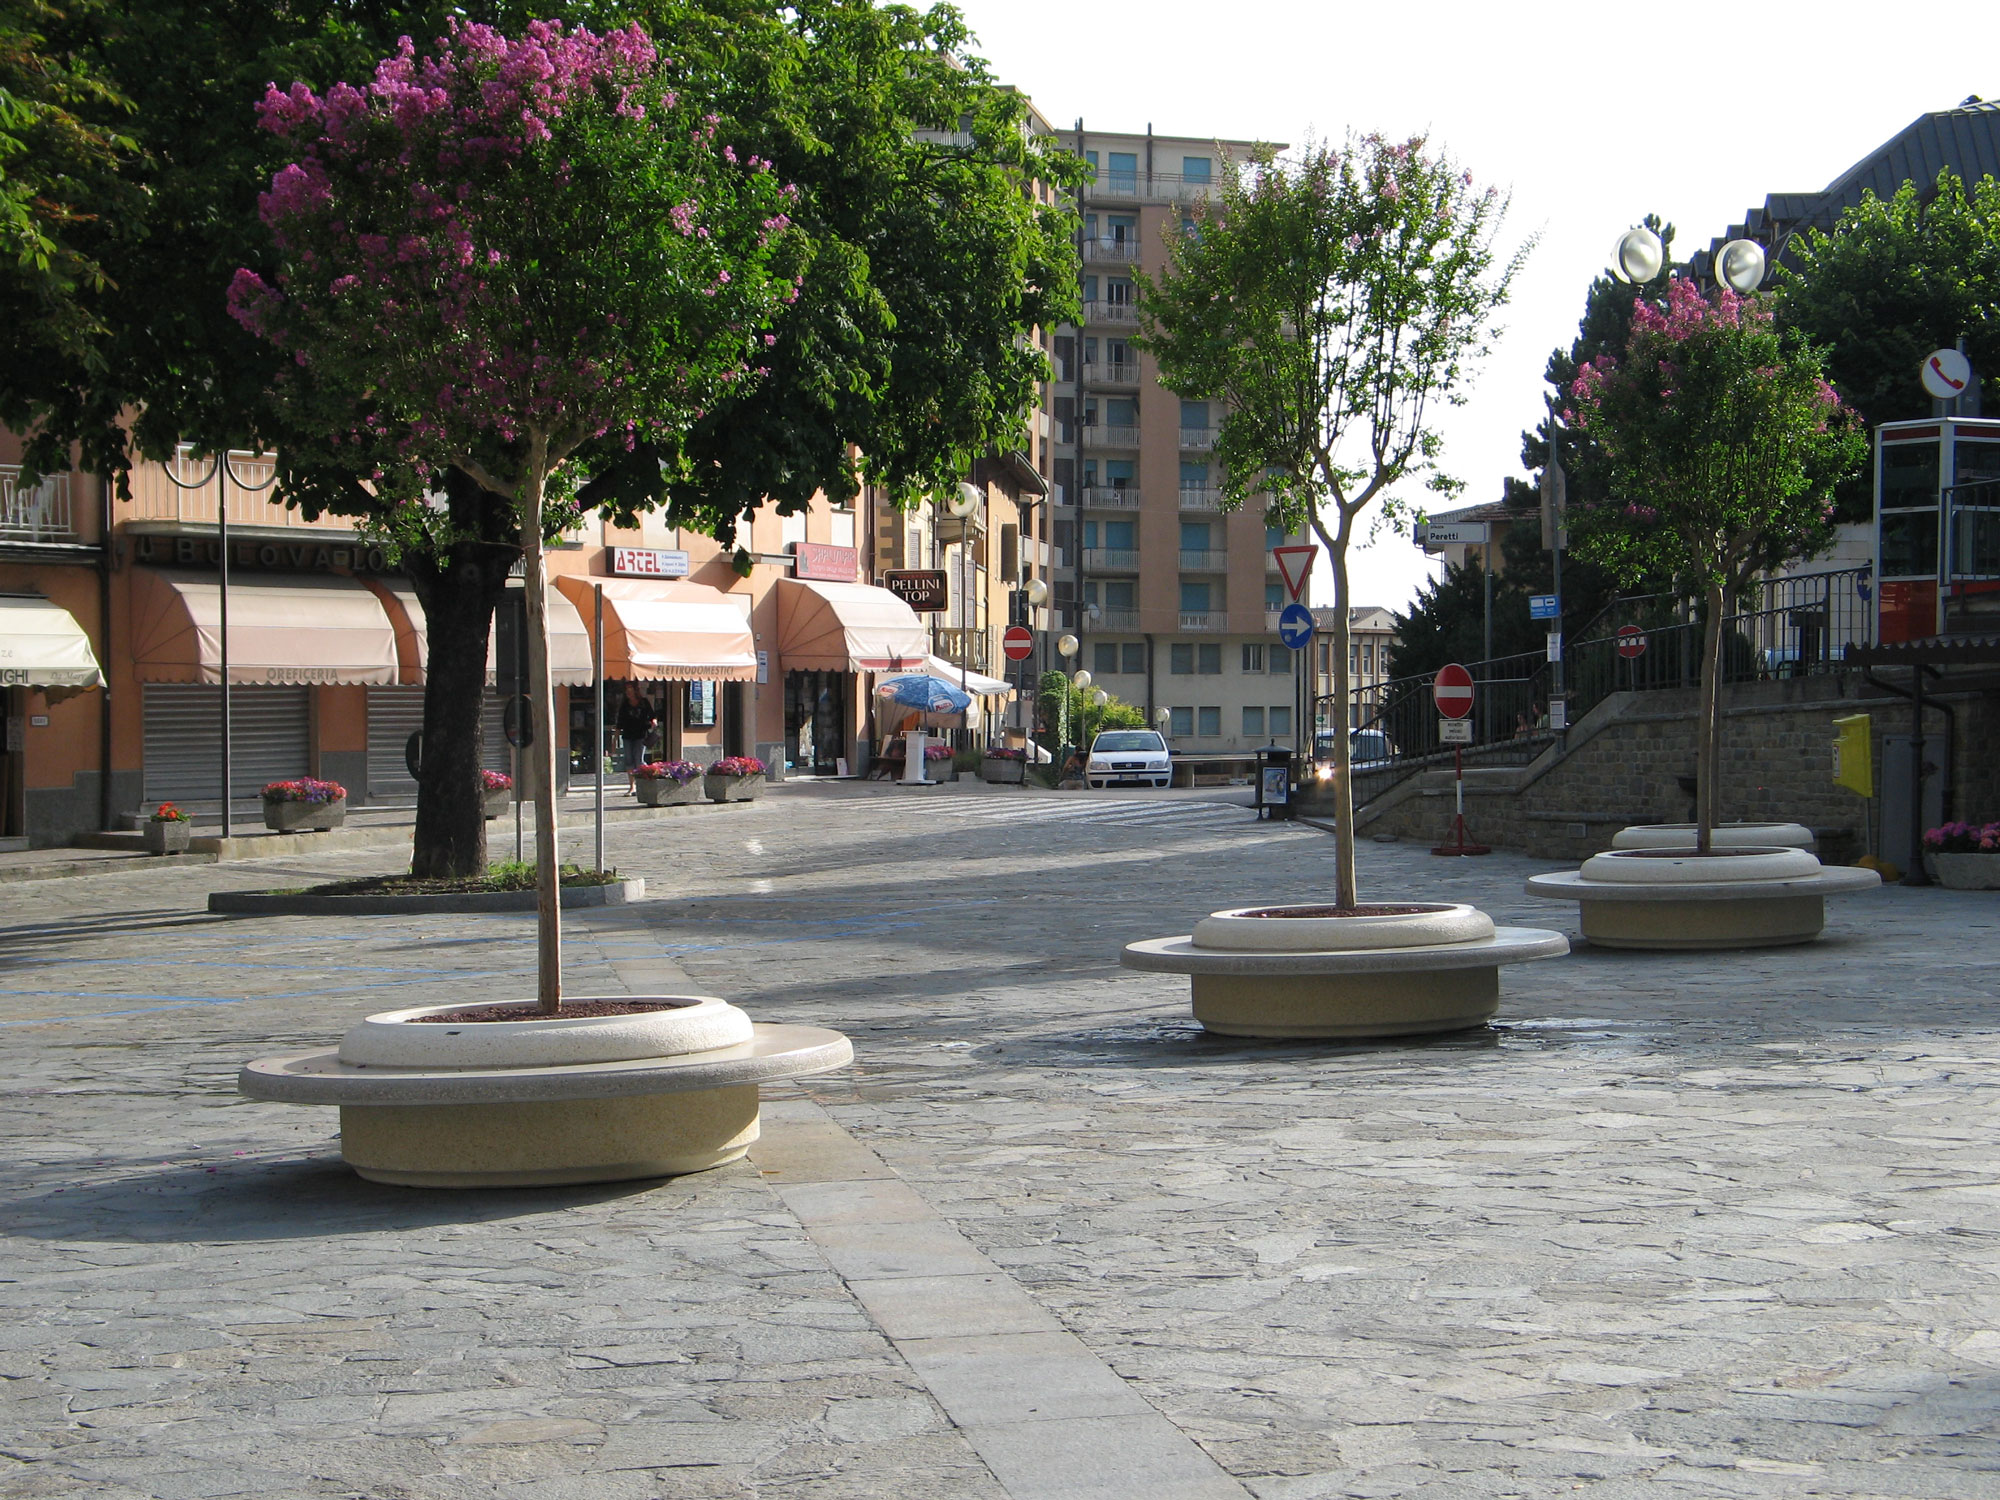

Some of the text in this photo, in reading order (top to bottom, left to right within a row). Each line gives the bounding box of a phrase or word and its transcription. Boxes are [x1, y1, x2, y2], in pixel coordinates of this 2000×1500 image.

[1430, 532, 1458, 543] Peretti
[177, 538, 326, 565] BULOVA
[616, 550, 661, 573] ARTEL
[892, 578, 940, 591] PELLINI
[902, 590, 931, 602] TOP
[266, 668, 338, 681] OREFICERIA
[656, 665, 735, 676] ELETTRODOMESTICI
